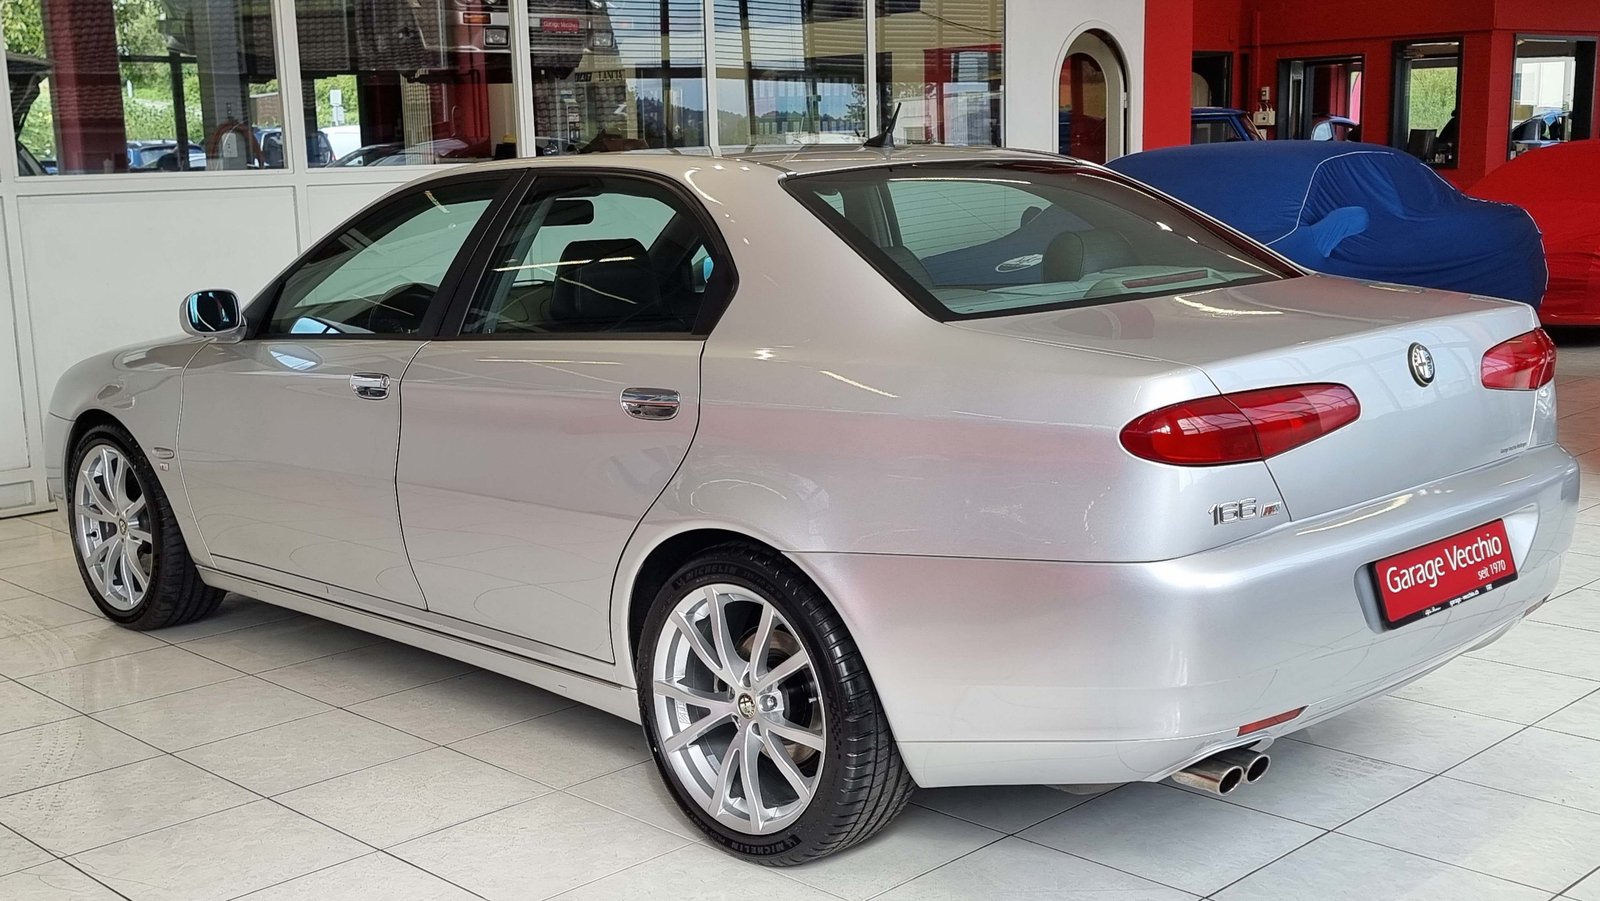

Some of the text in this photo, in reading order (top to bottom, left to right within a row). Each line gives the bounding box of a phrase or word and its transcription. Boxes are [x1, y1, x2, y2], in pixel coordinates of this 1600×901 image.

[1207, 497, 1257, 526] 166
[685, 564, 738, 580] MICHELIN
[1386, 533, 1503, 594] Garage Vecchio
[1477, 559, 1507, 580] seit 1970
[731, 842, 785, 855] MICHELIN
